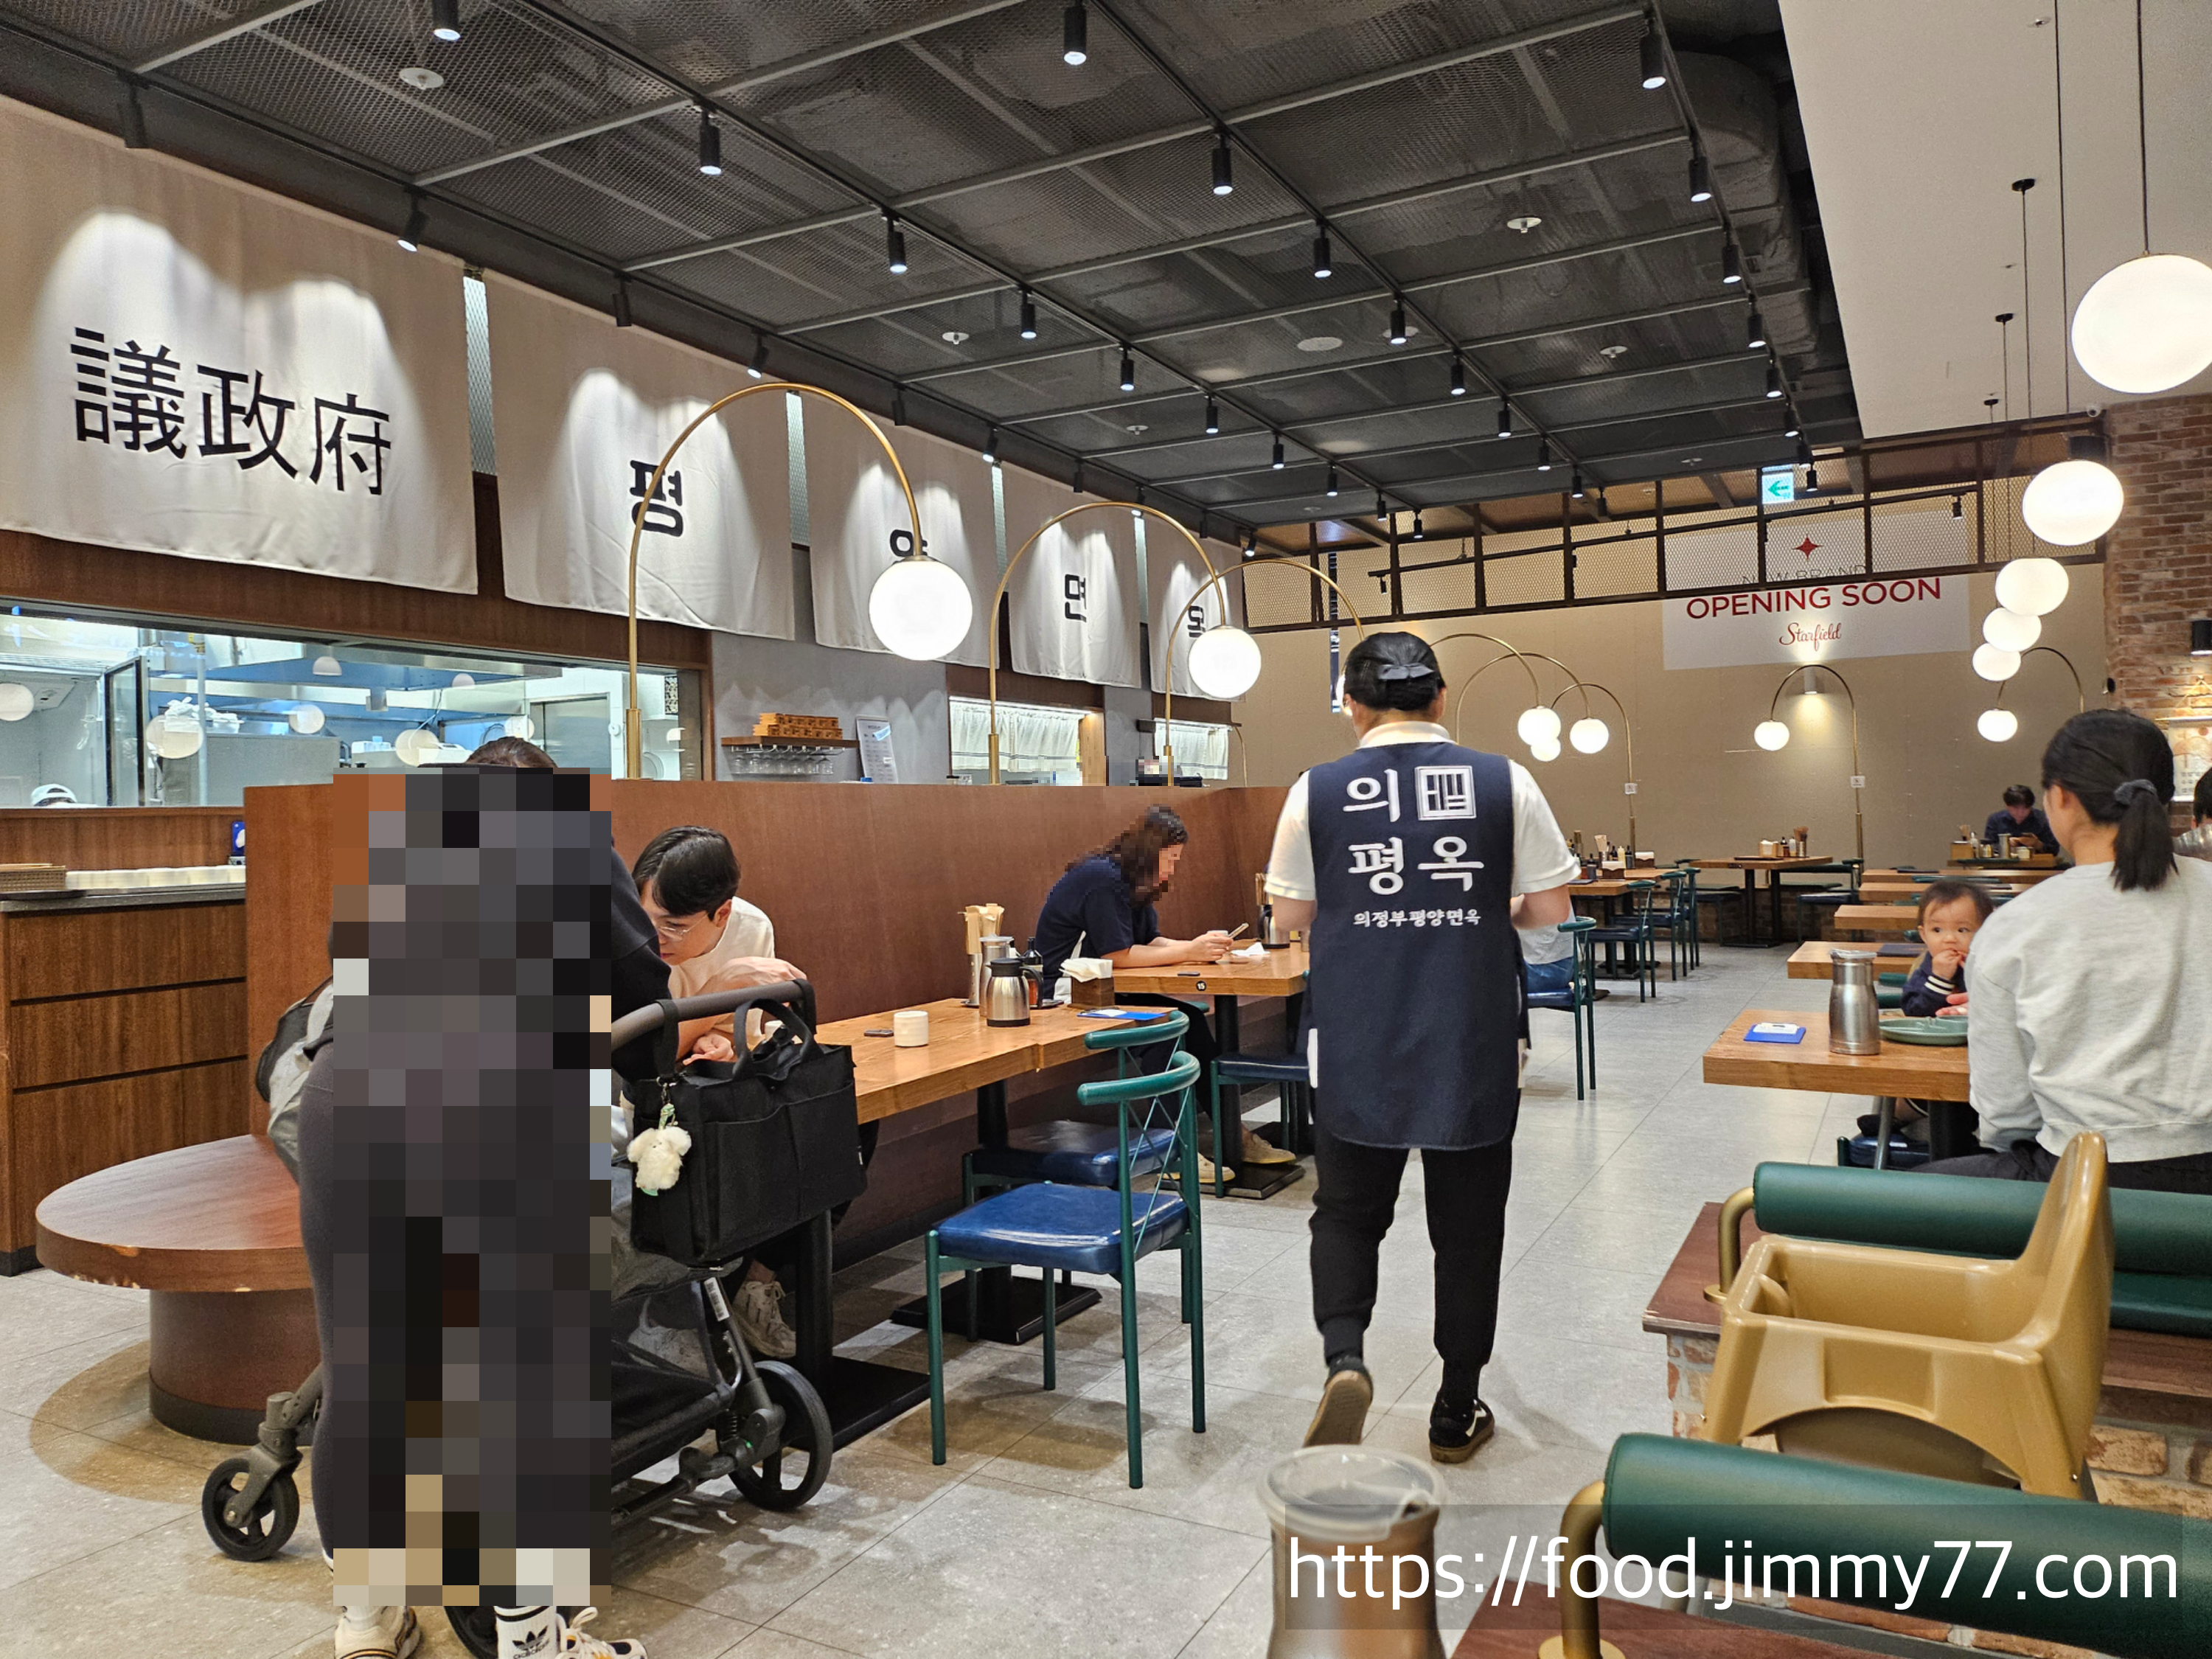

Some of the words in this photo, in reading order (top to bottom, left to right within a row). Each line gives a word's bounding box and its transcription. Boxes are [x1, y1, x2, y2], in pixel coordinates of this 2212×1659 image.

[70, 327, 392, 495] 議政府
[629, 459, 684, 538] 평
[1686, 587, 1831, 619] OPENING
[1842, 577, 1941, 606] SOON
[1779, 622, 1843, 652] Starfield
[1353, 908, 1482, 928] 의정부평양면옥
